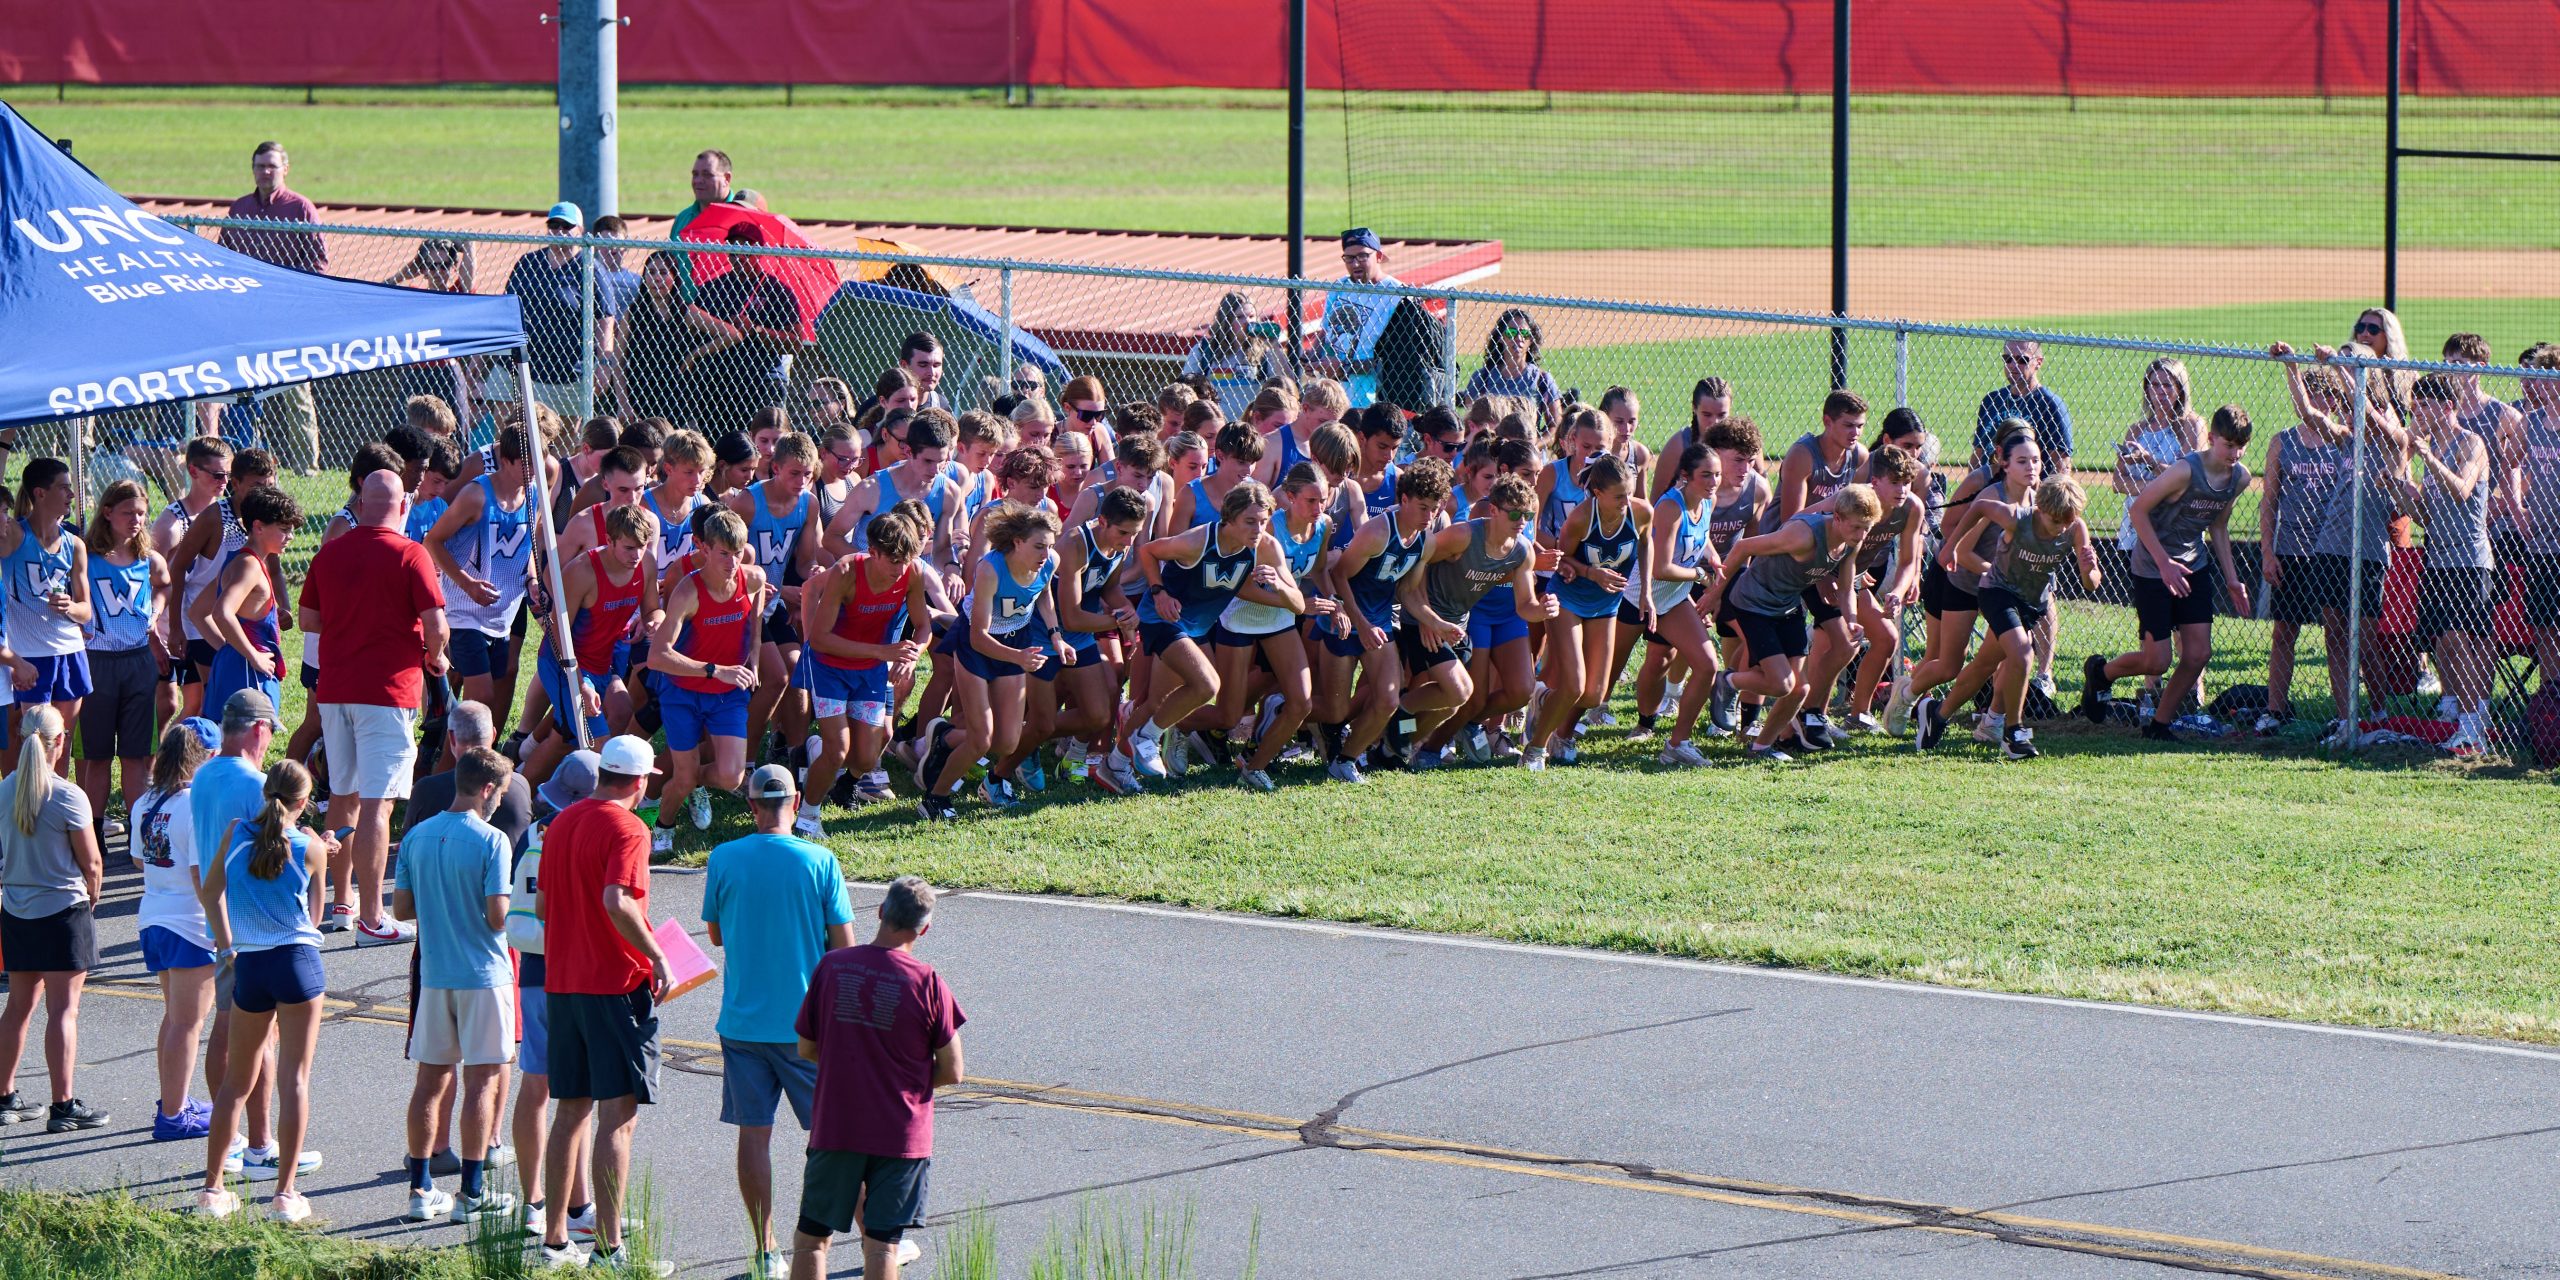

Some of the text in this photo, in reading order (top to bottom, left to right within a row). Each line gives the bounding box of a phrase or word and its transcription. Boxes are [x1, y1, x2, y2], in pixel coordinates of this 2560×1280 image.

[13, 204, 185, 253] UNC
[59, 250, 213, 280] HEALTH
[84, 272, 263, 304] Blue Ridge
[49, 329, 450, 416] SPORTS MEDICINE
[2531, 445, 2560, 460] INDIAN
[2291, 462, 2334, 474] INDIANS
[1370, 505, 1386, 514] TITAN
[2190, 499, 2227, 510] INDIANS
[489, 522, 530, 559] W
[1709, 520, 1743, 532] DIANS
[1712, 534, 1727, 544] XC
[657, 533, 696, 571] W
[757, 527, 799, 566] W
[1584, 540, 1635, 569] W
[2018, 548, 2061, 564] INDIANS
[1084, 552, 1124, 593] W
[1203, 560, 1251, 591] W
[1374, 552, 1419, 583] W
[1465, 569, 1505, 582] INDIANS
[94, 577, 144, 617] W
[1471, 583, 1487, 592] XC
[703, 611, 745, 626] FREEDOM
